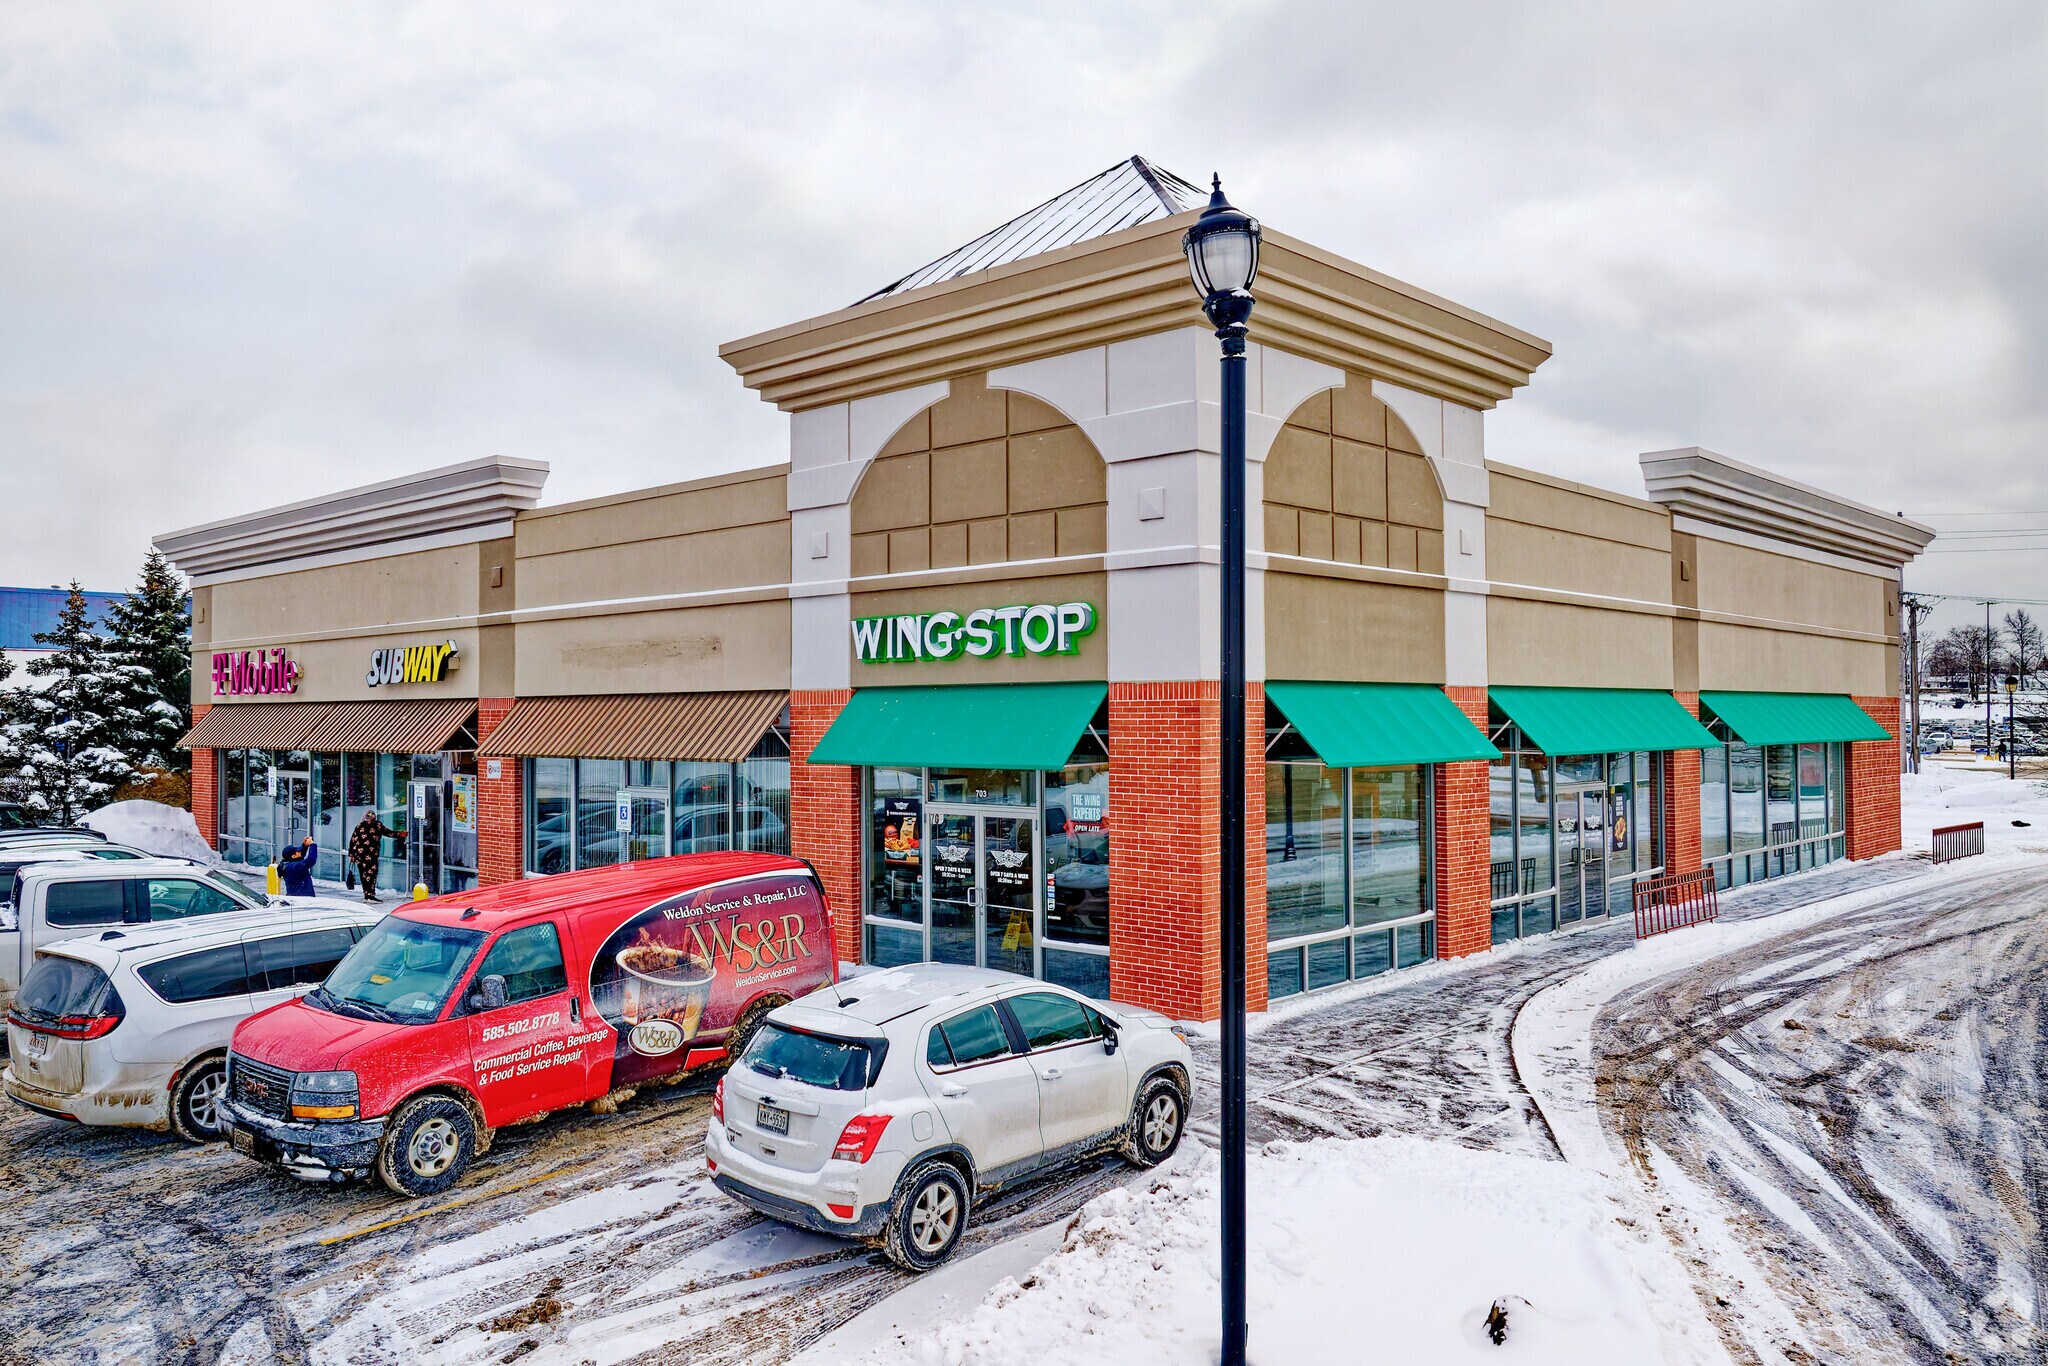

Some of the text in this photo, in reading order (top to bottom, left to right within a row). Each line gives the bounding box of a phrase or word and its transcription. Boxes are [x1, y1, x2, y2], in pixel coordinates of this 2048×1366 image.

[365, 640, 458, 687] SUBWAY
[975, 789, 988, 798] 703
[1072, 794, 1100, 806] THE WING
[1073, 807, 1100, 820] EXPERTS
[663, 885, 807, 921] Weldon Service & Repair, LLC
[685, 913, 812, 974] WS&R
[735, 965, 797, 988] WeldonService.com
[482, 1011, 560, 1042] 585.502.8778
[636, 1026, 678, 1048] WS&R
[474, 1029, 608, 1072] Commercial Coffee, Beverage
[479, 1049, 583, 1086] & Food Service Repair
